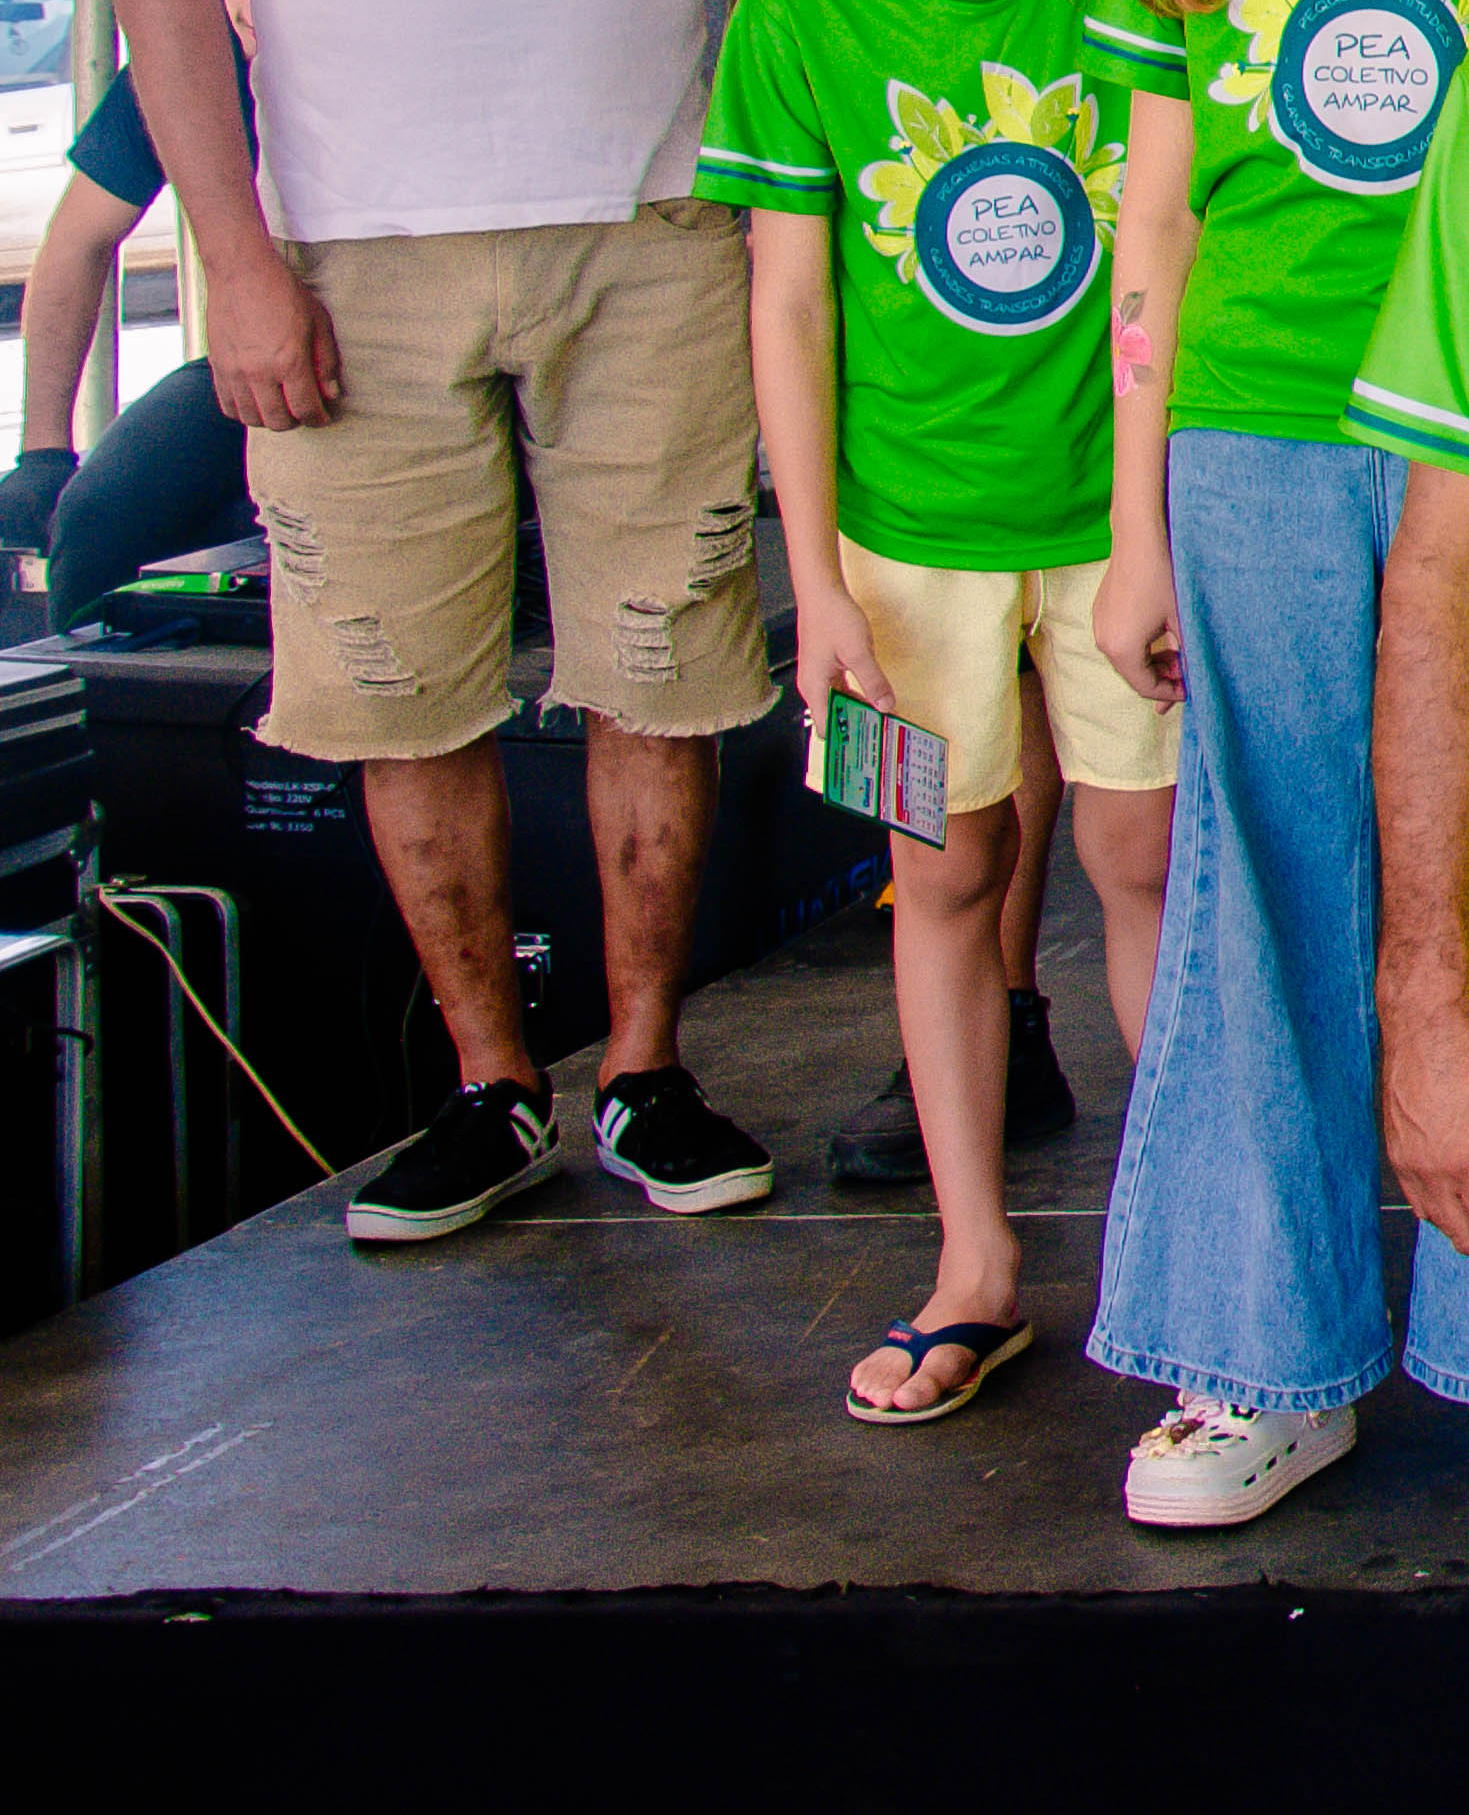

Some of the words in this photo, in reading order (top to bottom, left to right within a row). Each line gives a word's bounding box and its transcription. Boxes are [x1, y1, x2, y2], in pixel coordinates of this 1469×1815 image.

[1335, 33, 1410, 60] PEA
[1314, 66, 1428, 85] COLETIVO
[1323, 92, 1418, 113] AMPAR
[1281, 82, 1324, 151] GRANDES
[1016, 155, 1075, 200] ATITUDES
[972, 195, 1039, 222] PEA
[957, 220, 1056, 245] COLETIVO
[969, 244, 1052, 266] AMPAR
